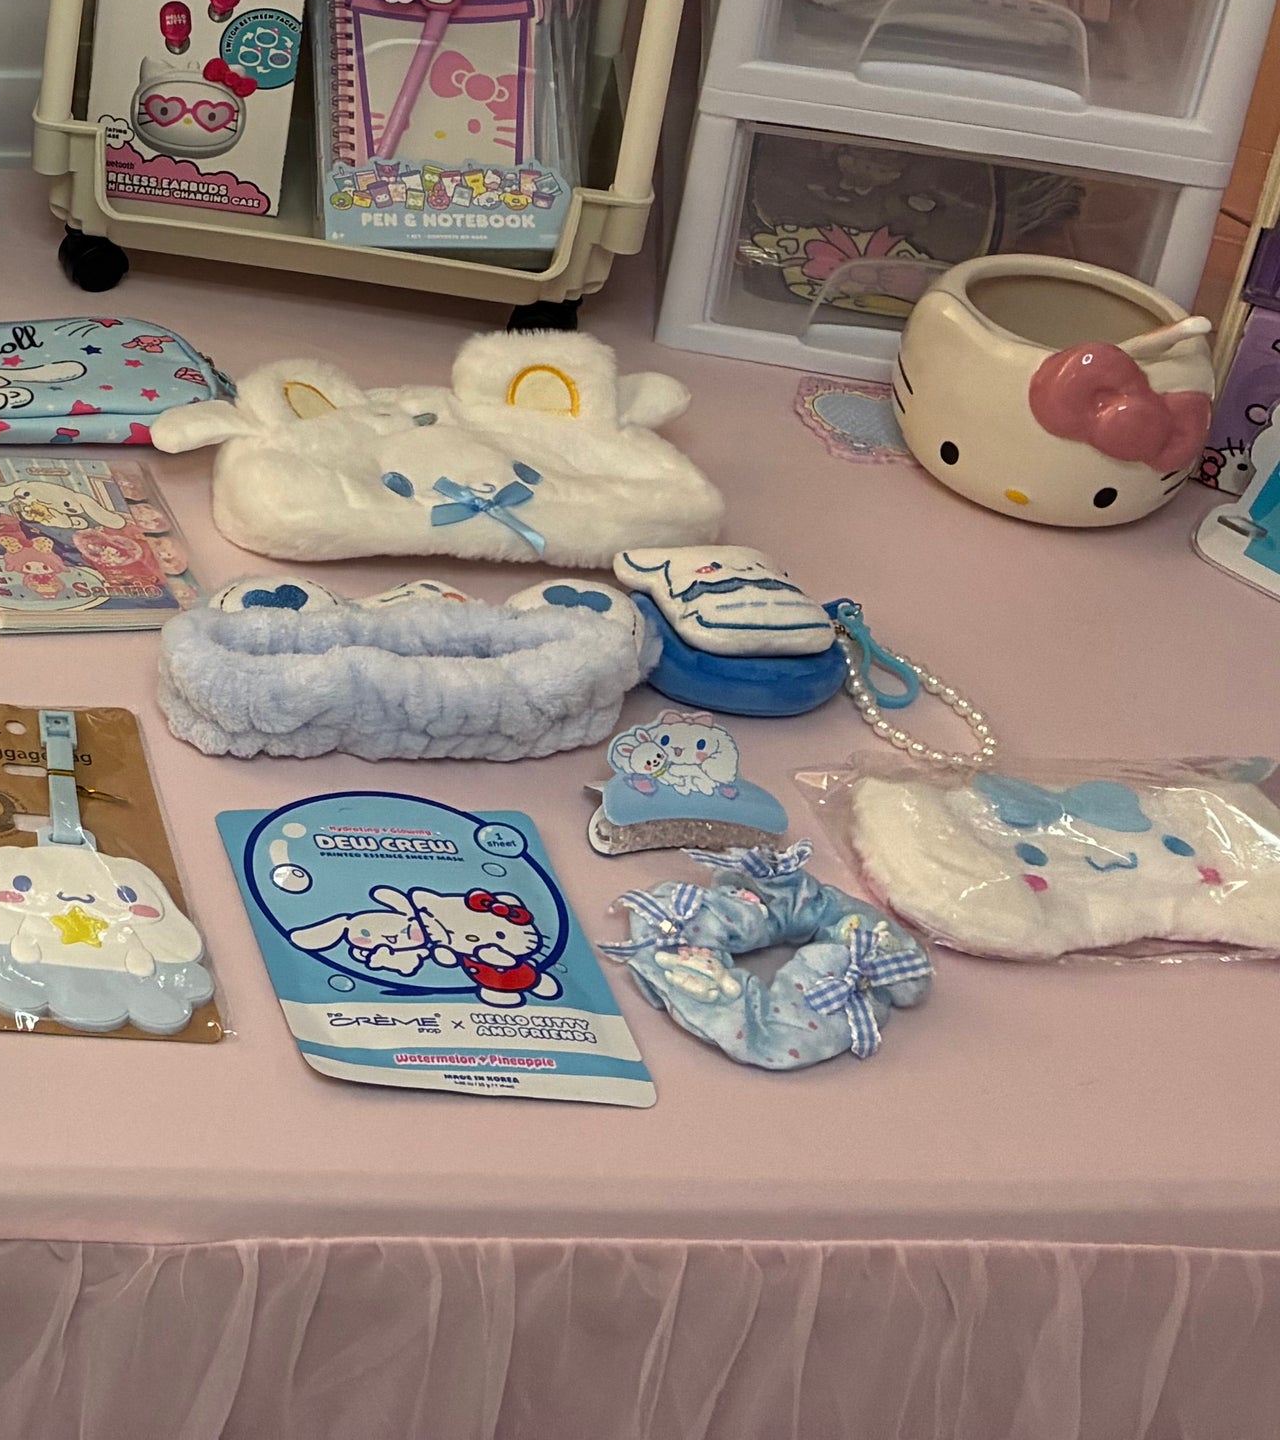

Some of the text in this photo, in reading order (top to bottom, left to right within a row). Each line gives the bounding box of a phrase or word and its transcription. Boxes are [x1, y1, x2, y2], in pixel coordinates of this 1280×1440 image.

[108, 172, 228, 195] RELESS EARBUDS
[119, 184, 261, 208] ROTATING CHARGING CASE
[361, 213, 398, 228] PEN
[423, 213, 536, 229] NOTEBOOK
[314, 834, 458, 855] DEW CREW
[487, 840, 516, 849] sheet
[470, 1013, 589, 1031] HELLO KITTY
[476, 1025, 597, 1044] AND FRIENDS
[395, 1053, 556, 1069] Watermelon Pineapple
[486, 1076, 519, 1084] KOREA
